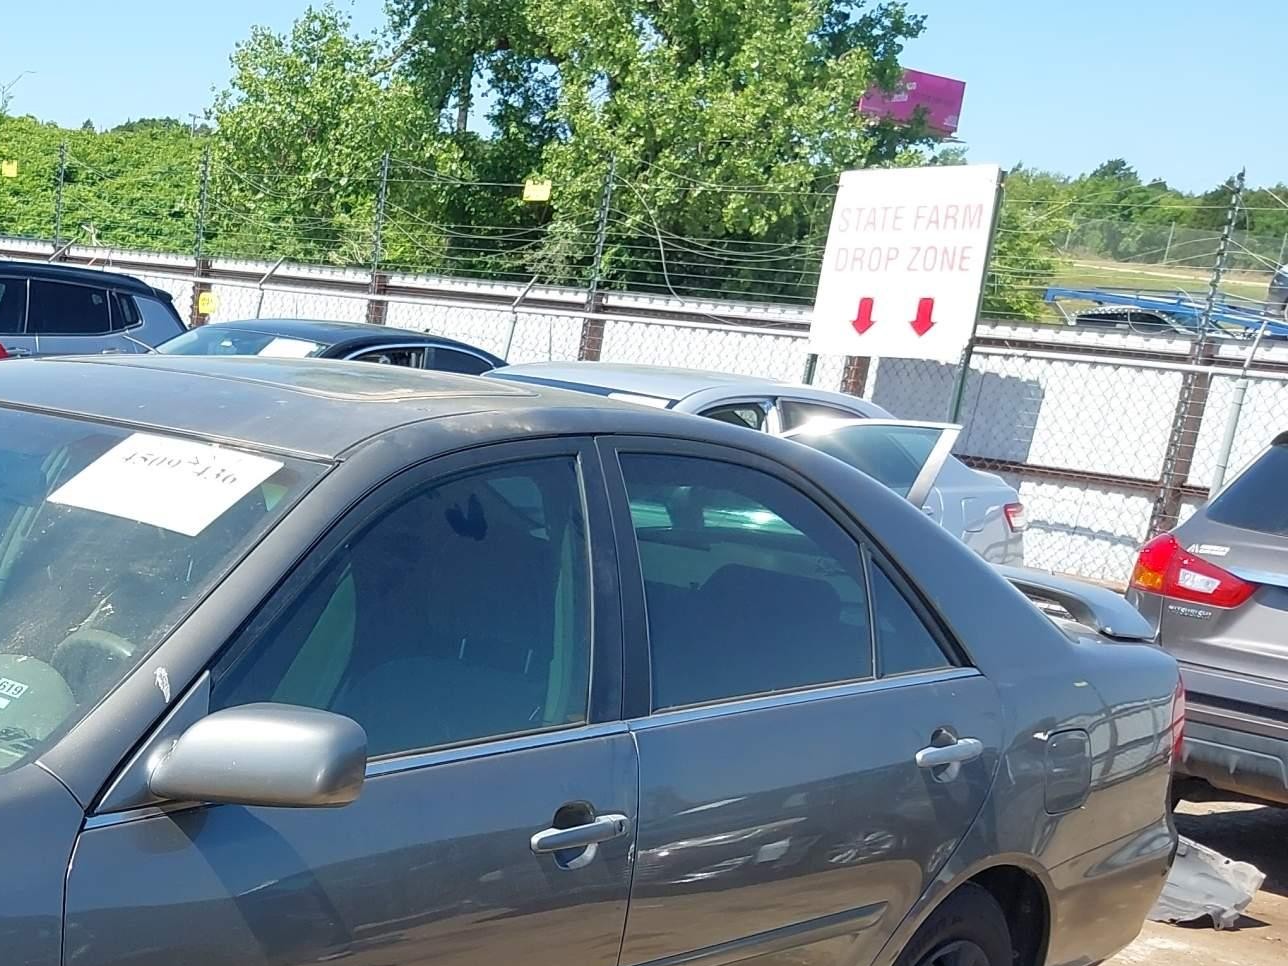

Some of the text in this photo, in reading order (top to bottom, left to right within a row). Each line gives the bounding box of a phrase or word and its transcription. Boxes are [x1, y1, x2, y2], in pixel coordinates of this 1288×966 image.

[838, 203, 983, 233] STATE FARM
[834, 245, 973, 272] DROP ZONE
